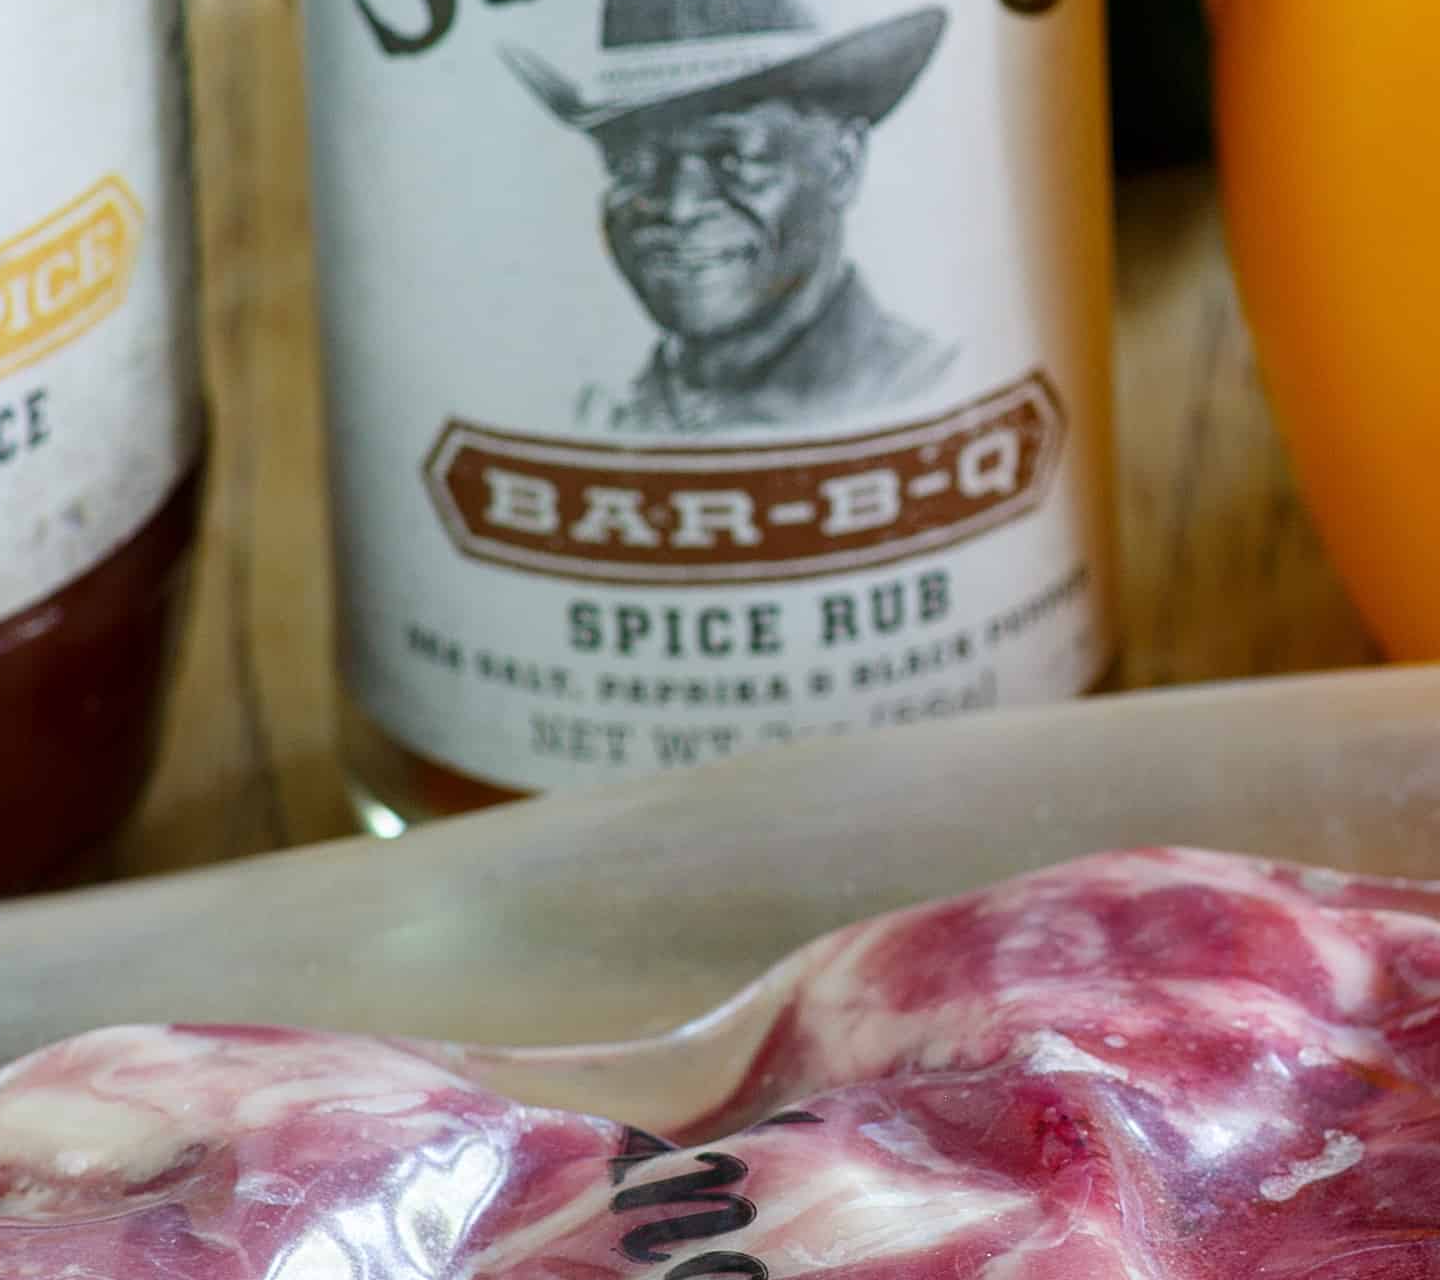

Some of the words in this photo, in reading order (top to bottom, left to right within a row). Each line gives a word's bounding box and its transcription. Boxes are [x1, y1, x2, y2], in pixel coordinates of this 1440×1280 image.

[481, 428, 1022, 548] BAR-B-Q
[567, 599, 784, 658] SPICE
[819, 569, 952, 647] RUB
